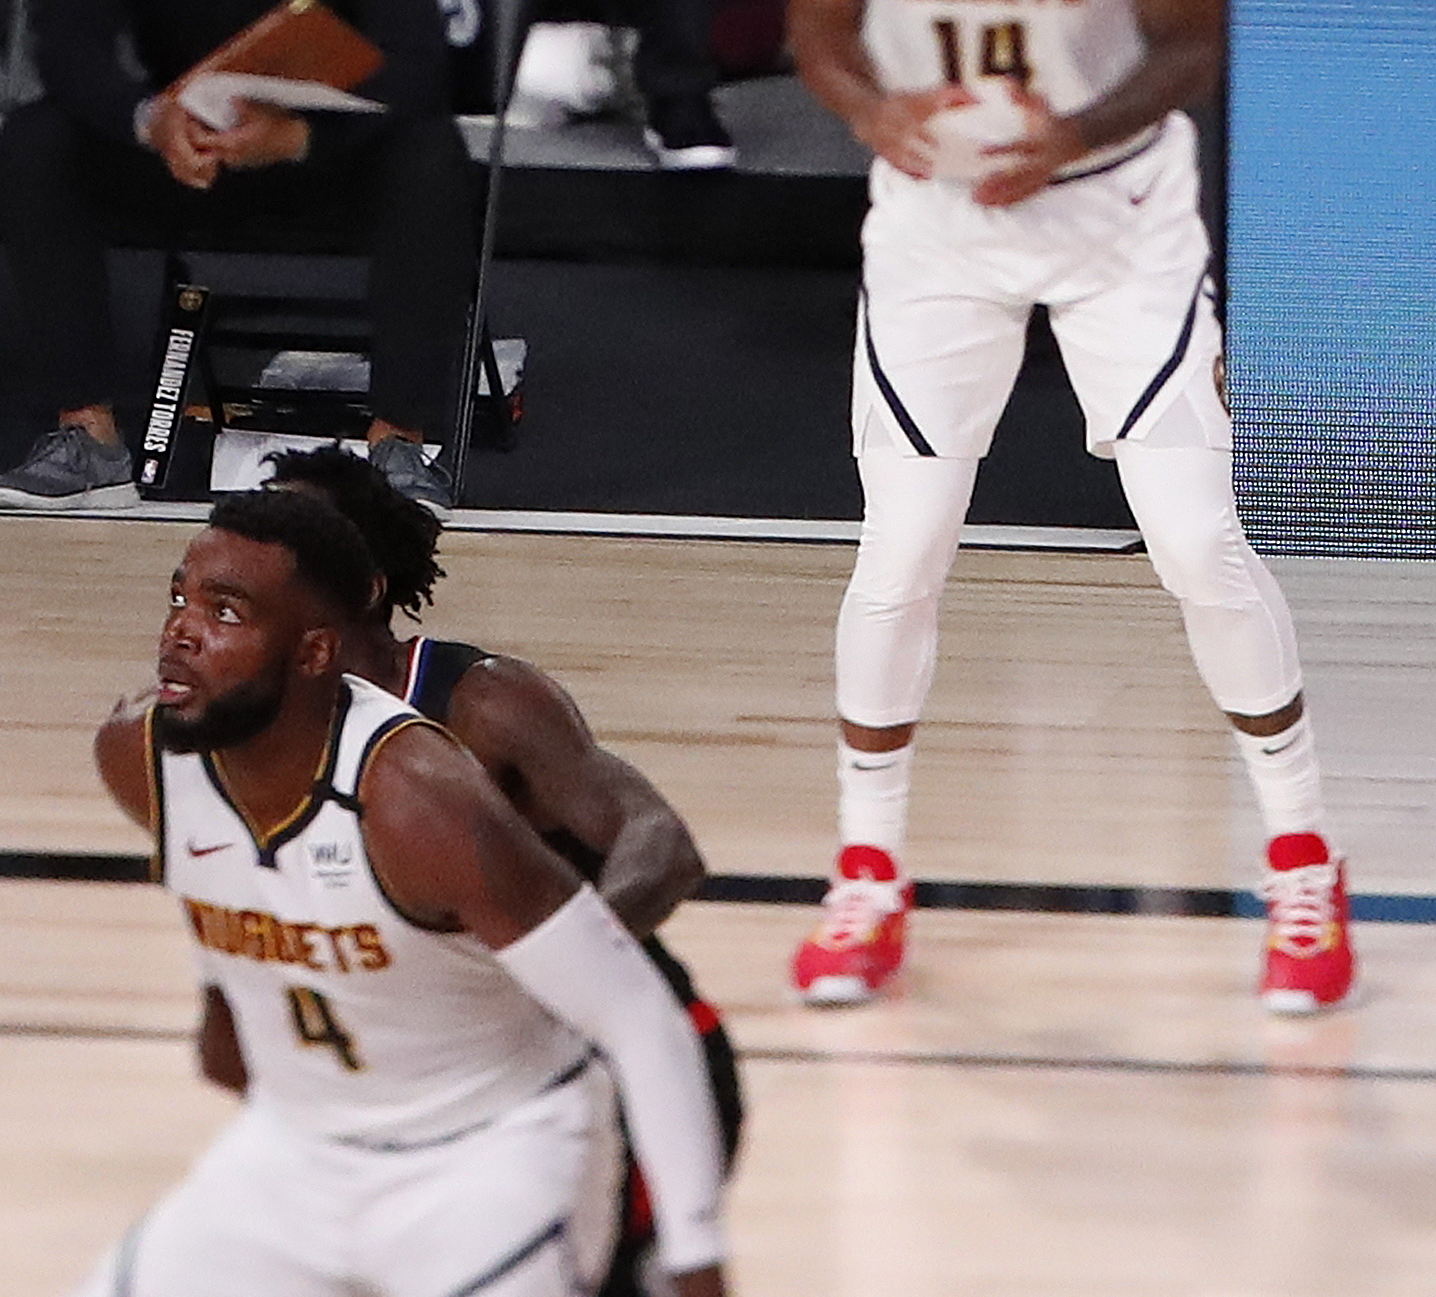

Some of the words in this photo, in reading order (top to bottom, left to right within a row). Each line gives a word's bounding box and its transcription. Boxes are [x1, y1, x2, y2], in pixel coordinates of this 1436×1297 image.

[933, 17, 1033, 85] 14
[156, 328, 195, 402] FERNANDEZ
[144, 403, 177, 453] TORRES
[184, 897, 393, 973] NUGGETS
[285, 984, 365, 1073] 4
